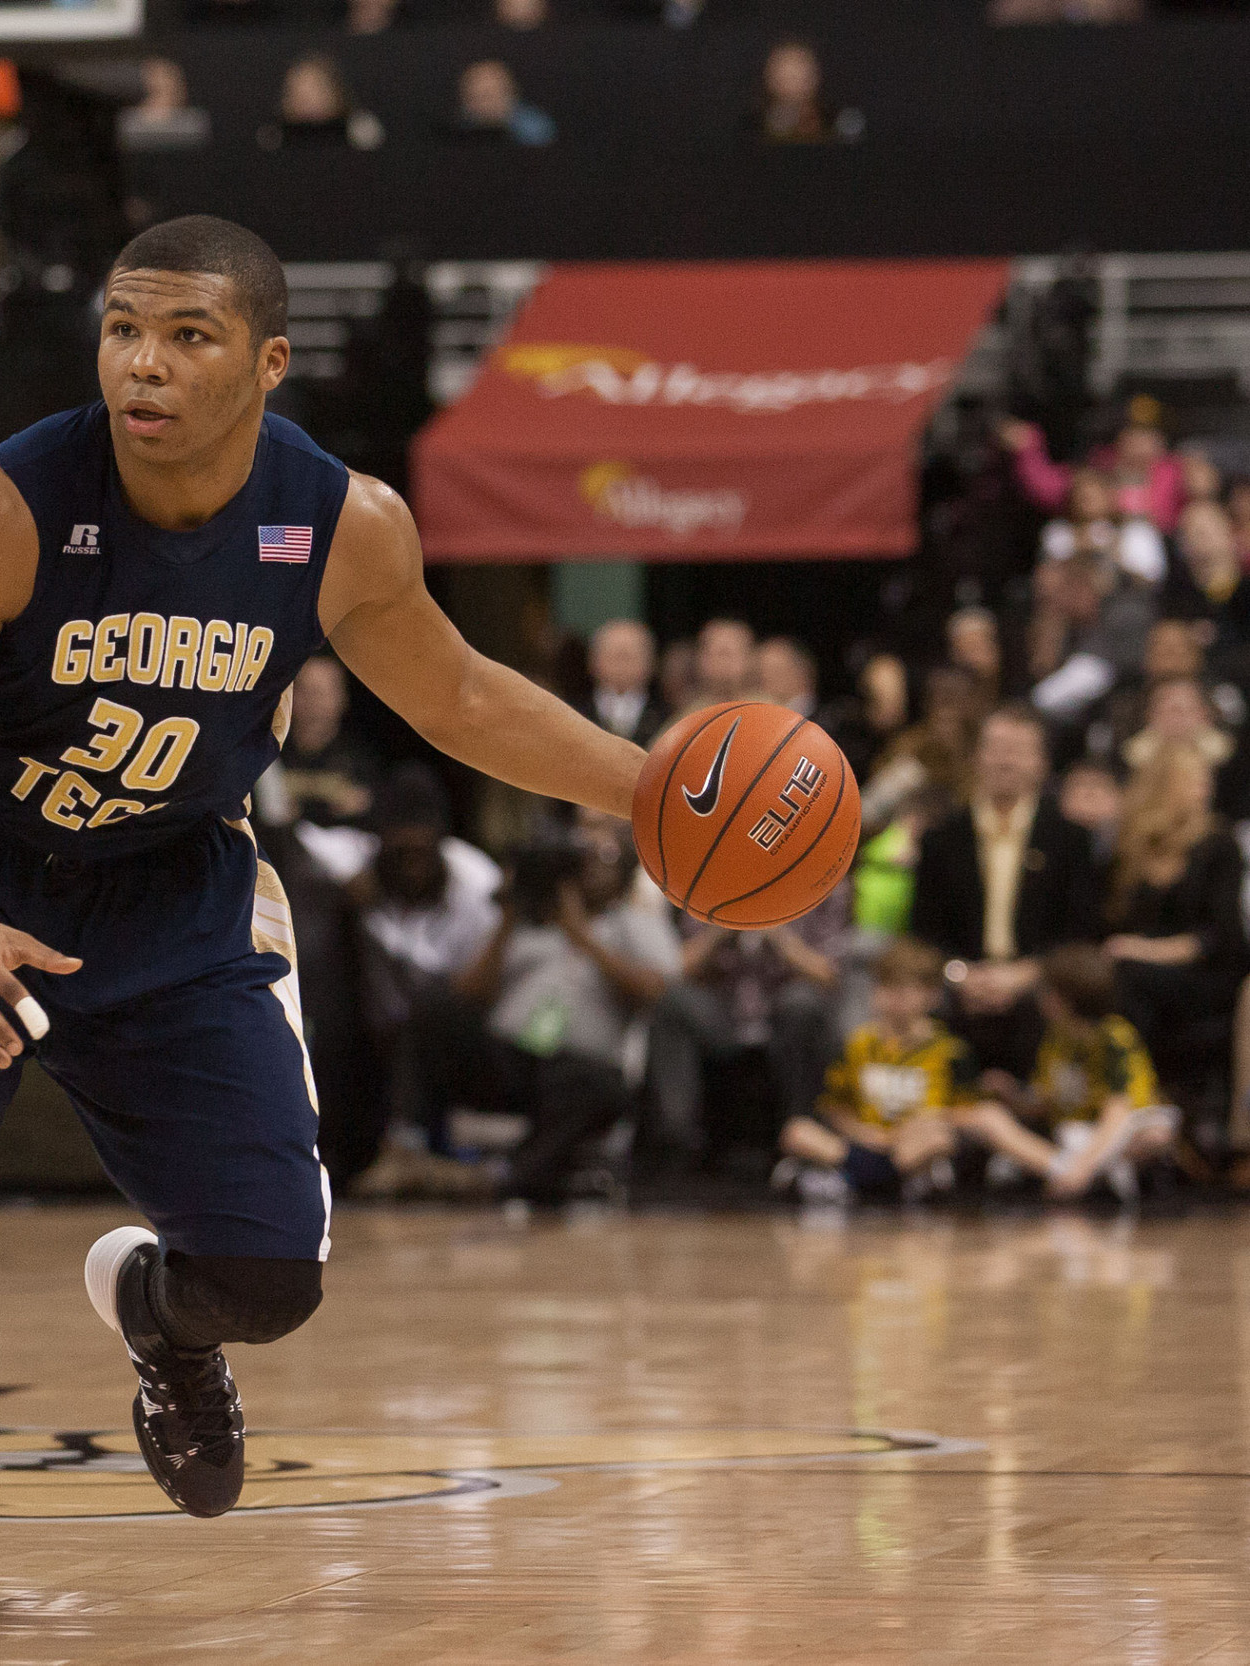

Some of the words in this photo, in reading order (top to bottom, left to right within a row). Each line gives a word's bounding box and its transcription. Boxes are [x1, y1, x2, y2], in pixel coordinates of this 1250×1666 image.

[52, 612, 274, 692] GEORGIA
[59, 697, 200, 791] 30
[11, 757, 169, 831] TEC
[747, 755, 823, 851] ELITE
[769, 773, 828, 857] CHAMPIONSHIP
